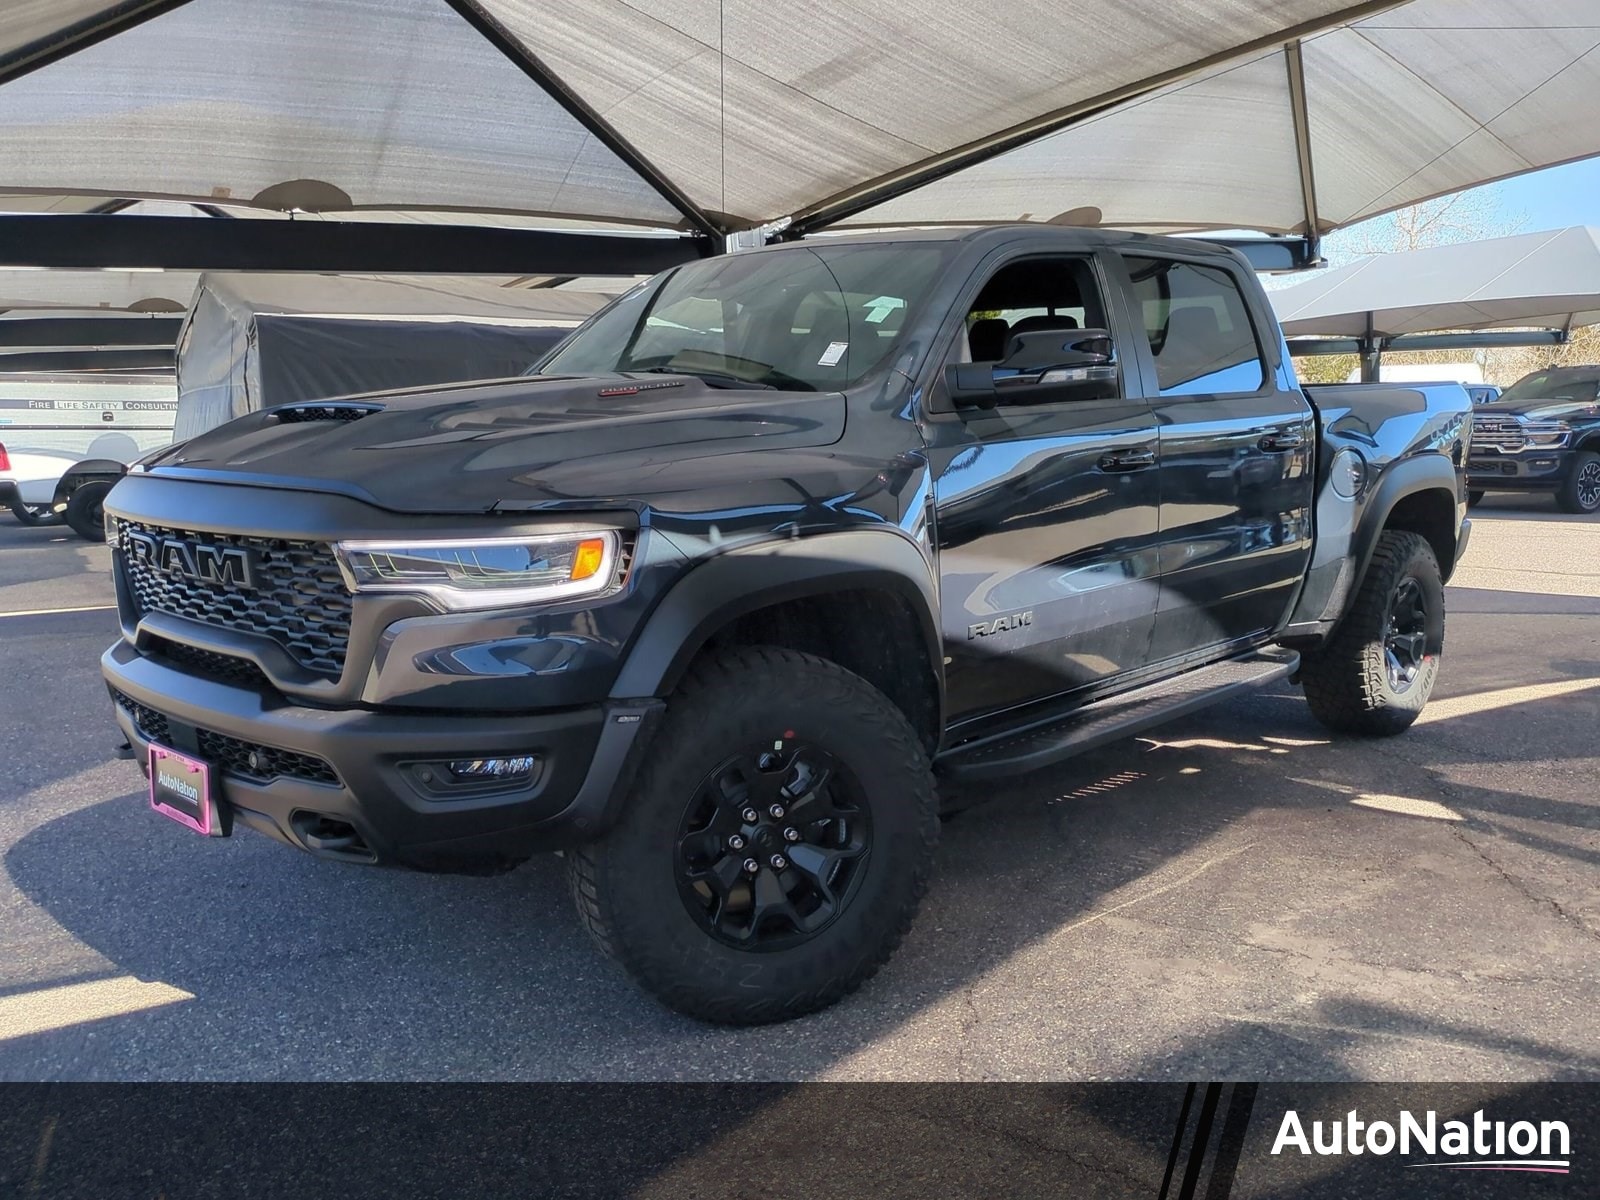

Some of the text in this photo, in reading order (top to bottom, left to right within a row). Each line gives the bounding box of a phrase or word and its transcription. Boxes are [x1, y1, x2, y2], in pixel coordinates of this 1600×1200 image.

[125, 401, 178, 410] CONSULTIN
[128, 529, 252, 587] RAM
[967, 611, 1033, 641] RAM
[158, 770, 198, 801] AutoNation
